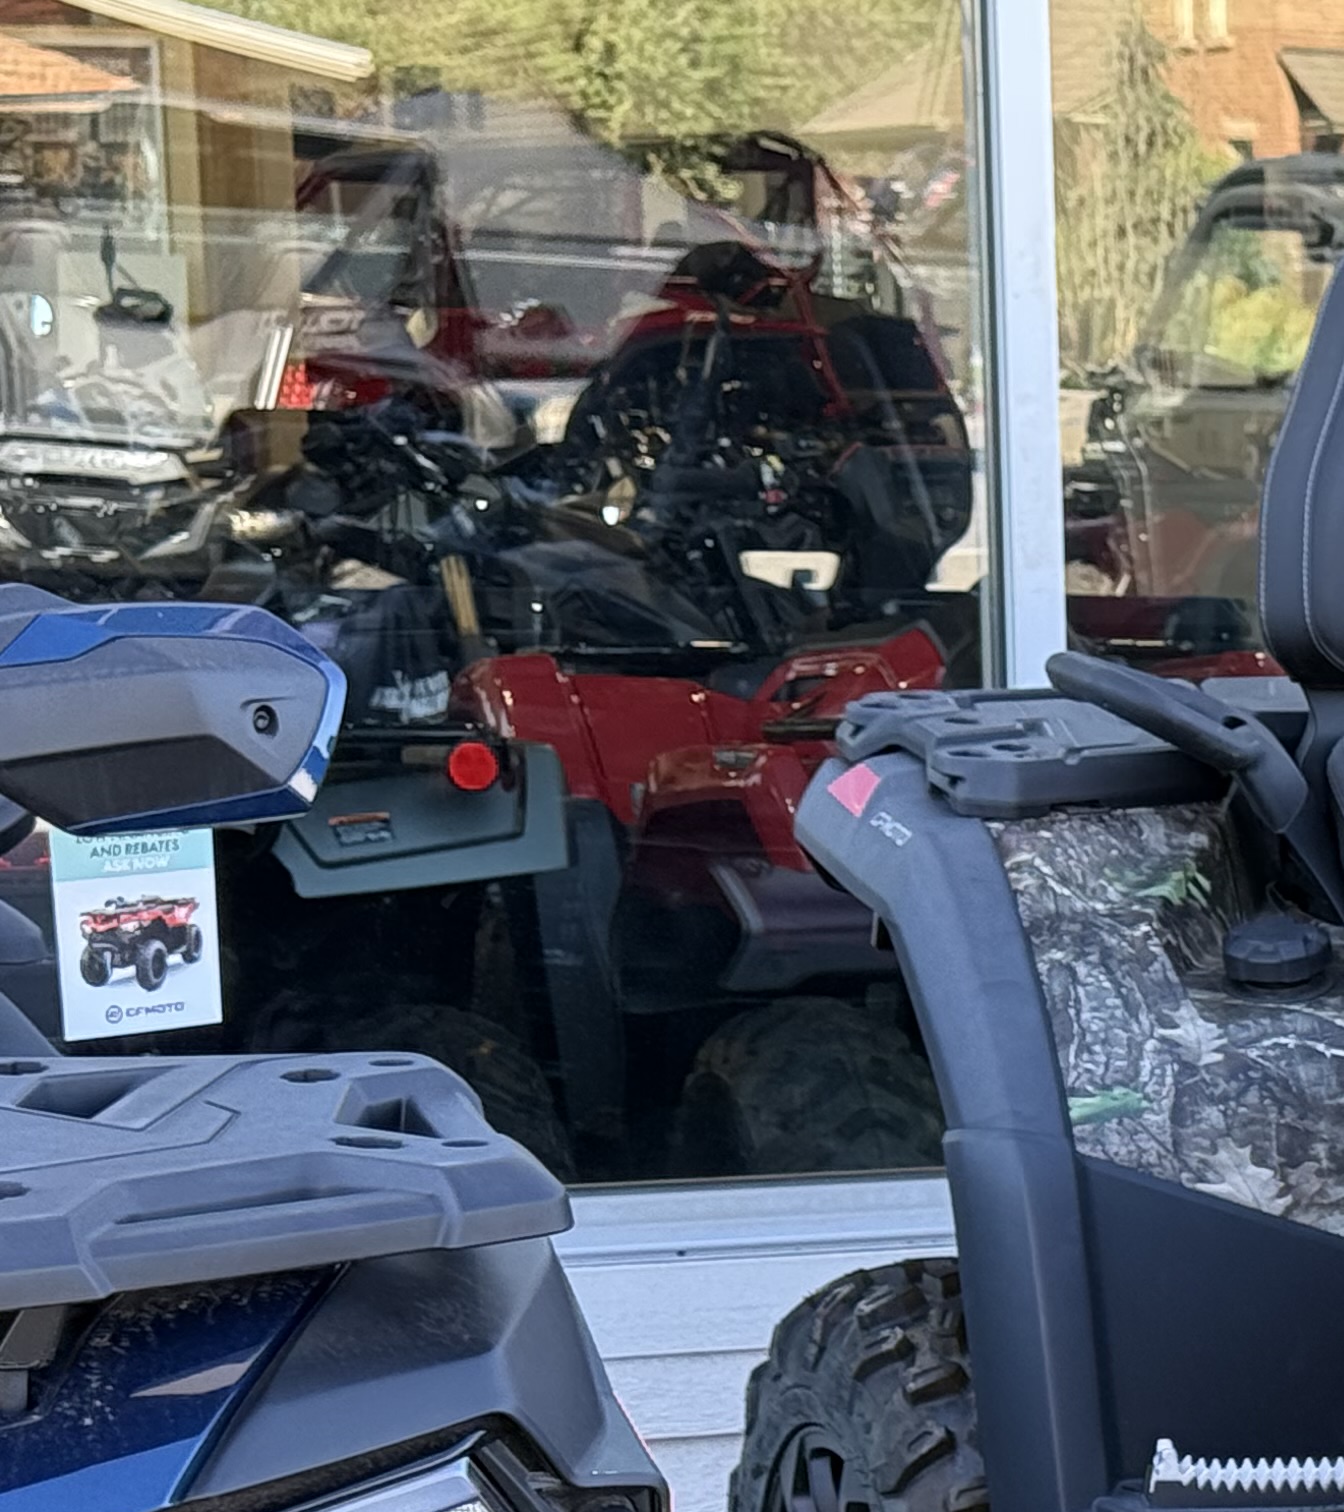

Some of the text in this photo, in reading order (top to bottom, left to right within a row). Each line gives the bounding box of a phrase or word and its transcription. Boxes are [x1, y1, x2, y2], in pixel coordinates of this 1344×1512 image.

[90, 838, 180, 859] AND REBATES
[103, 856, 170, 873] ASK NOW
